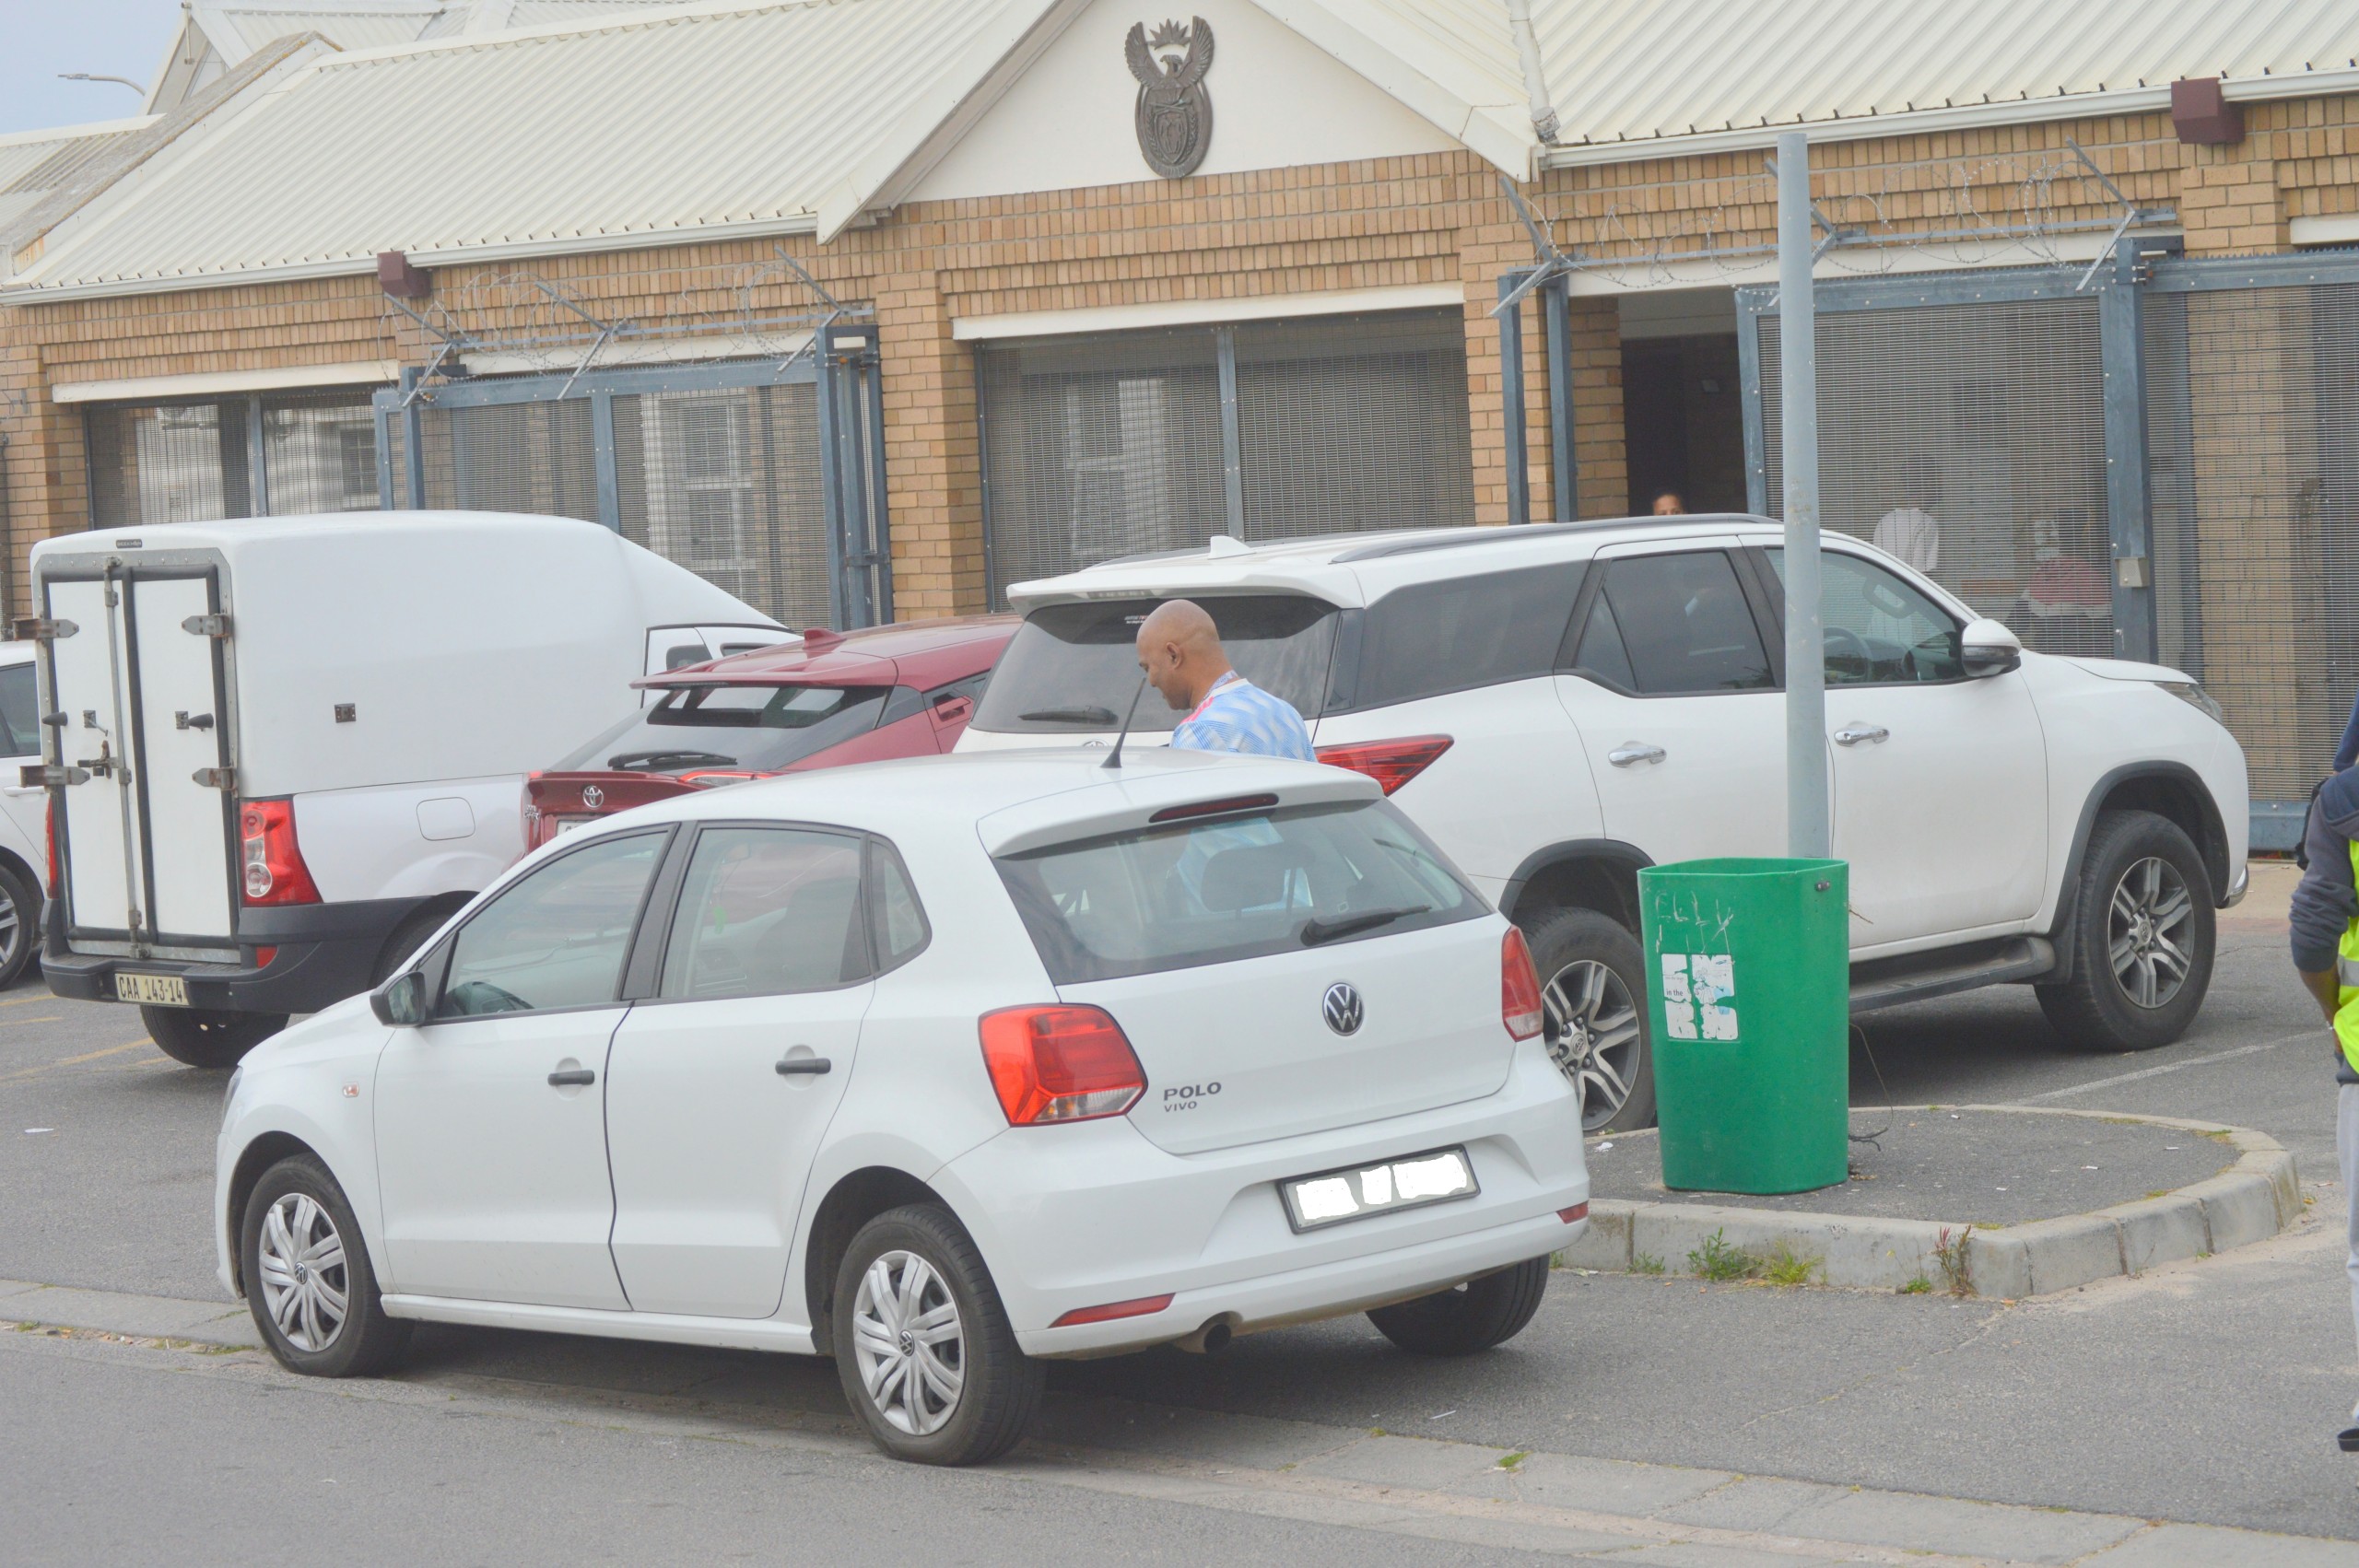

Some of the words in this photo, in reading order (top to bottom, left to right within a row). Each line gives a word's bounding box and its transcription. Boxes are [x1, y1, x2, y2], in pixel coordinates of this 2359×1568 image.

[119, 977, 140, 1000] CAA
[1164, 1082, 1222, 1101] POLO
[1164, 1101, 1198, 1113] VIVO
